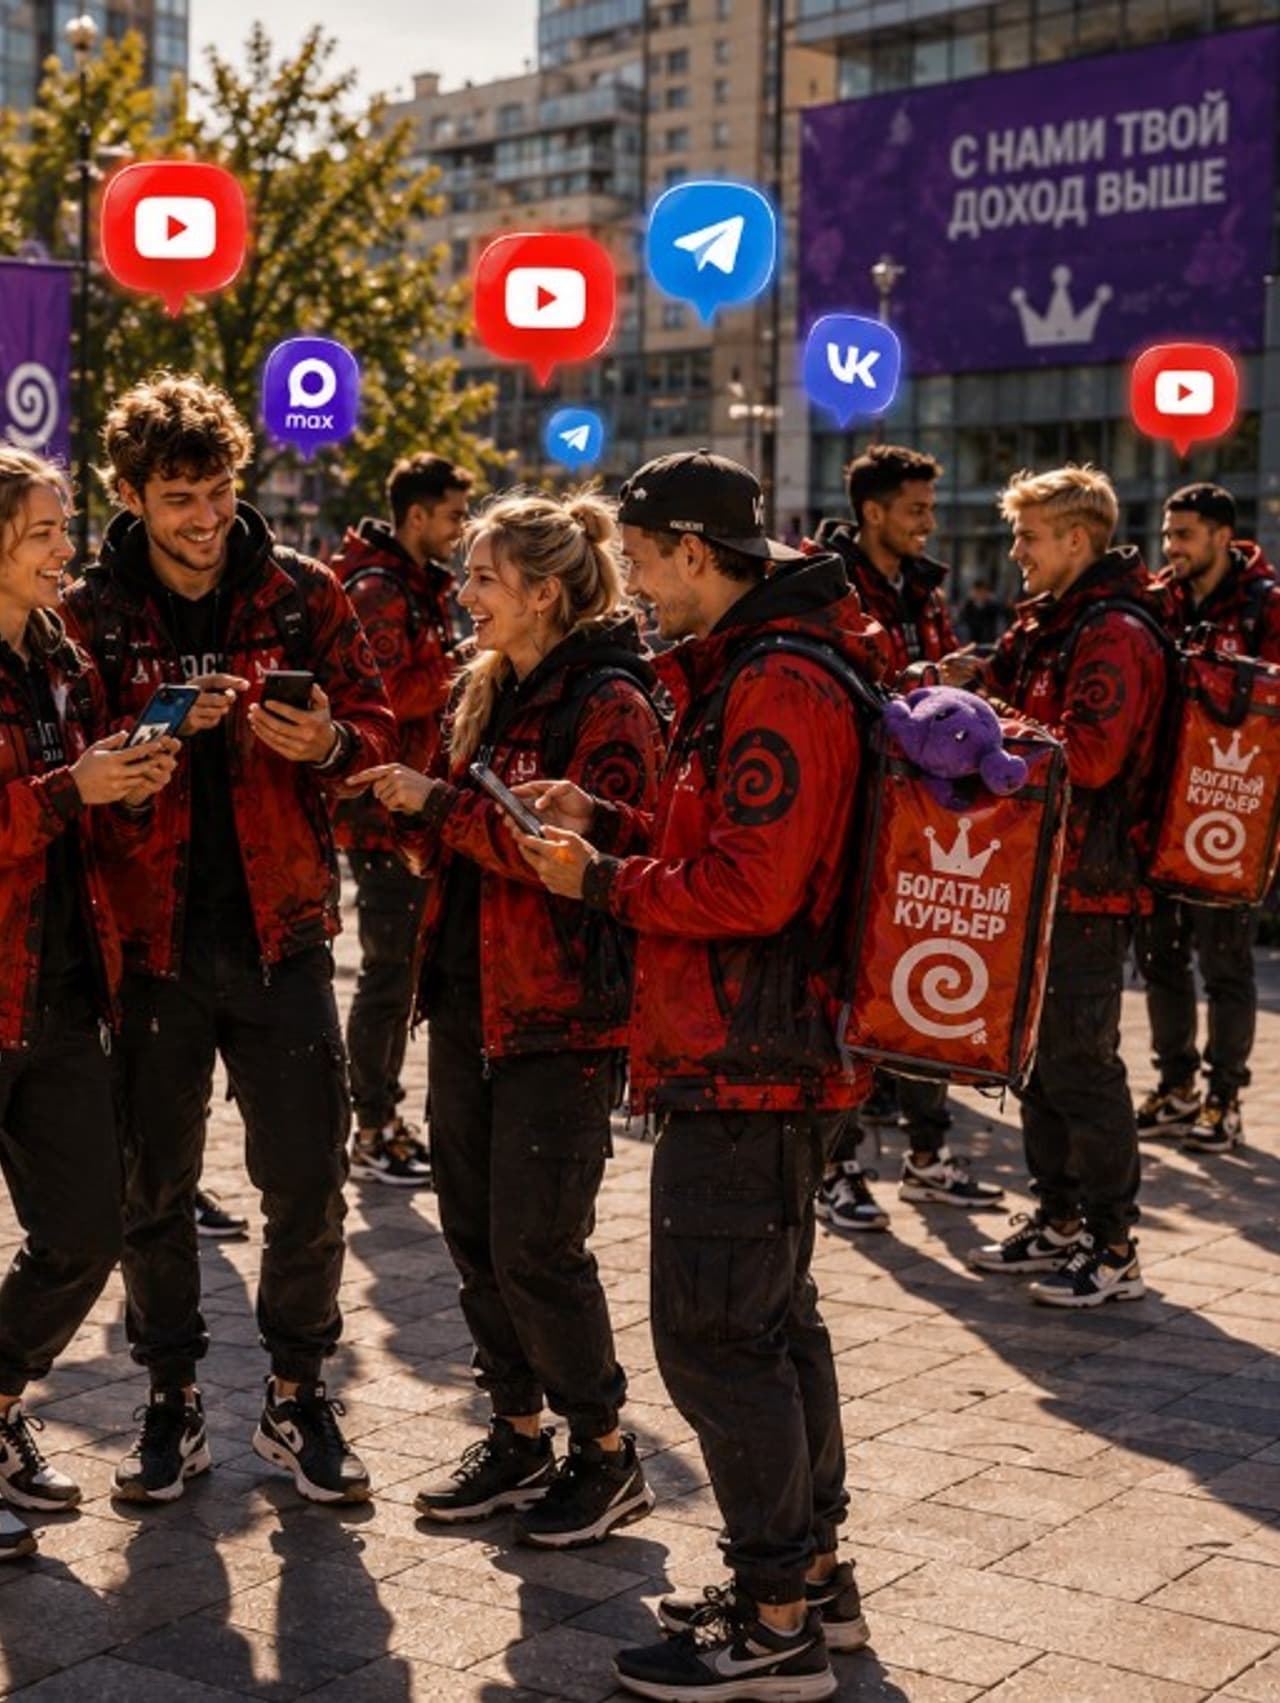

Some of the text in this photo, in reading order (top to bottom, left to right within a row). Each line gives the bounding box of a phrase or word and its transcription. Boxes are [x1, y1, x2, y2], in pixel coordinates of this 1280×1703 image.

[950, 90, 1228, 179] С НАМИ ТВОЙ
[947, 159, 1227, 241] ДОХОД ВЫШЕ
[1186, 784, 1261, 815] КУРЬЕР
[1189, 766, 1265, 797] БОГАТЫЙ
[896, 871, 1012, 914] БОГАТЫЙ
[893, 899, 1007, 941] КУРЬЕР
